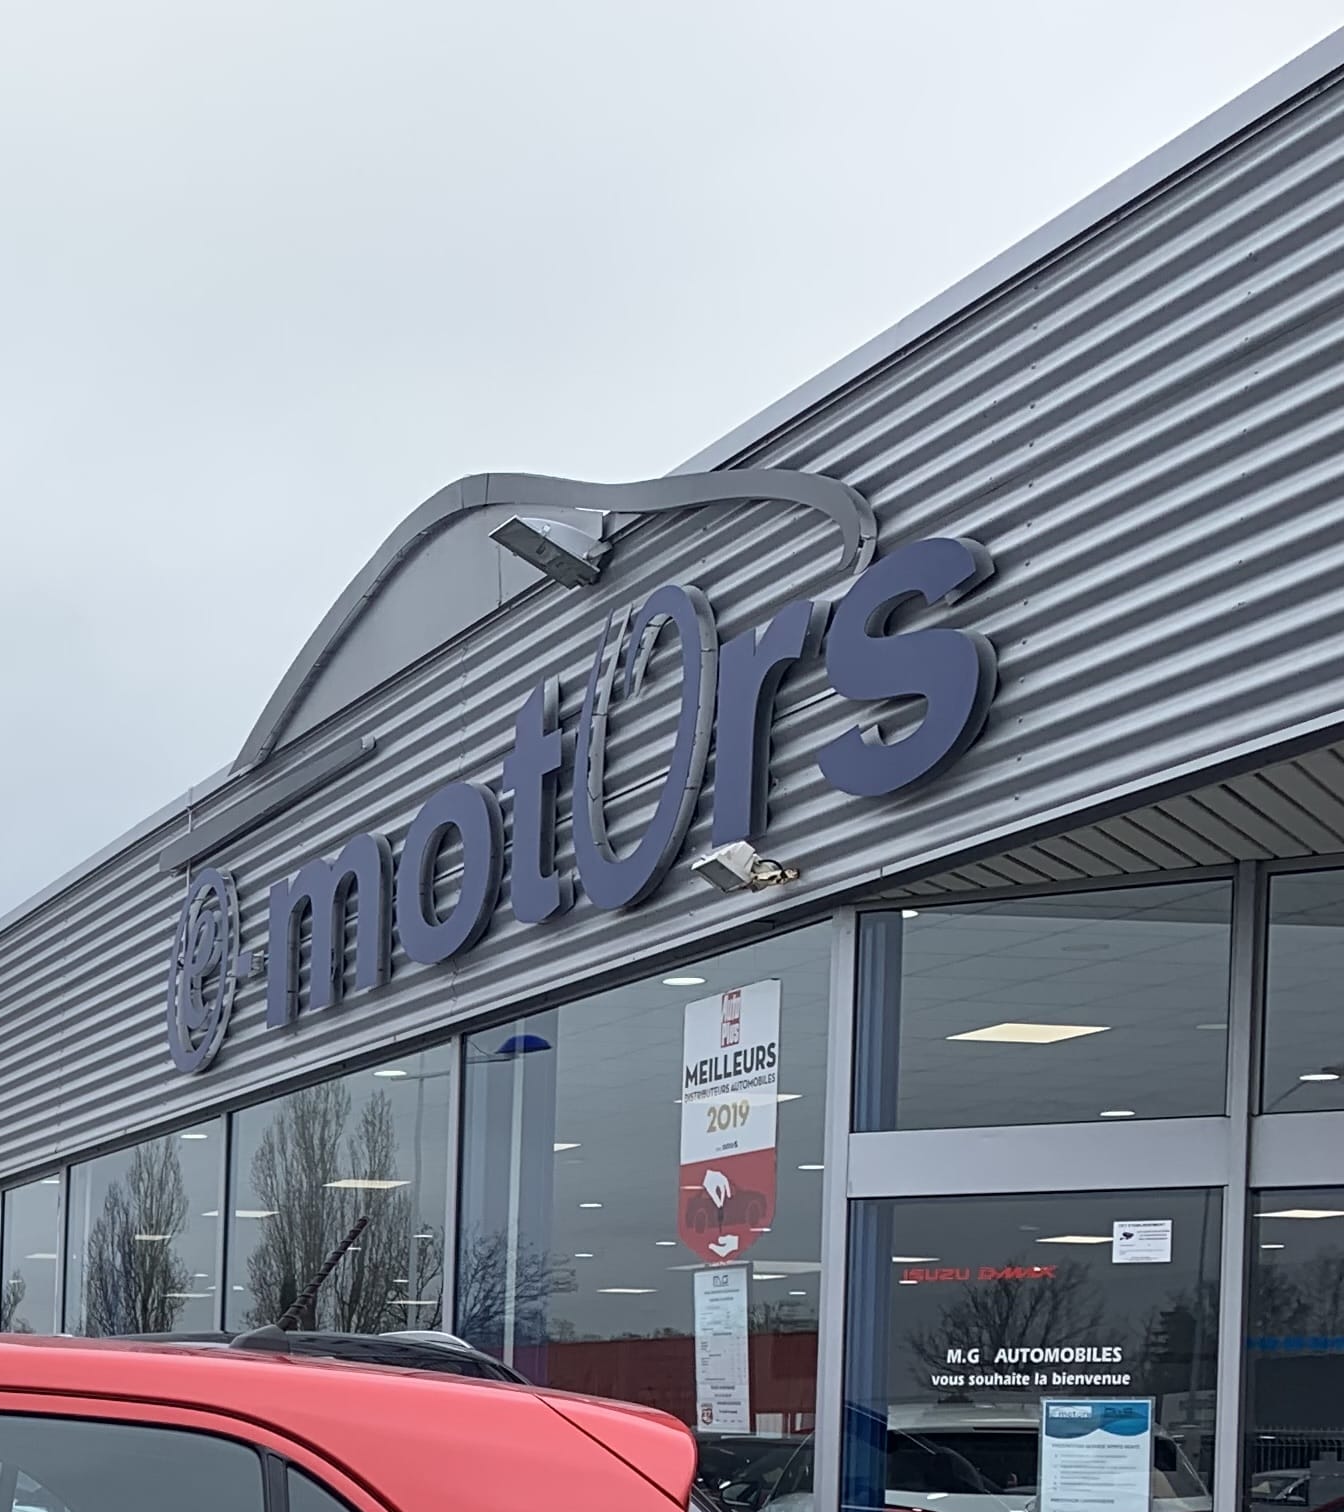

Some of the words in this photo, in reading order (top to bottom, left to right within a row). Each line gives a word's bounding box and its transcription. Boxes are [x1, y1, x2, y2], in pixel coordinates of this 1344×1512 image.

[685, 1042, 777, 1089] MEILLEURS
[731, 1072, 776, 1092] AUTOMOBILES
[707, 1099, 750, 1133] 2019
[902, 1268, 970, 1281] ISUZU
[946, 1348, 980, 1364] M.G
[994, 1347, 1122, 1364] AUTOMOBILES
[932, 1374, 964, 1386] vous
[968, 1372, 1030, 1386] souhaite
[1034, 1372, 1048, 1386] la
[1052, 1371, 1131, 1386] bienvenue
